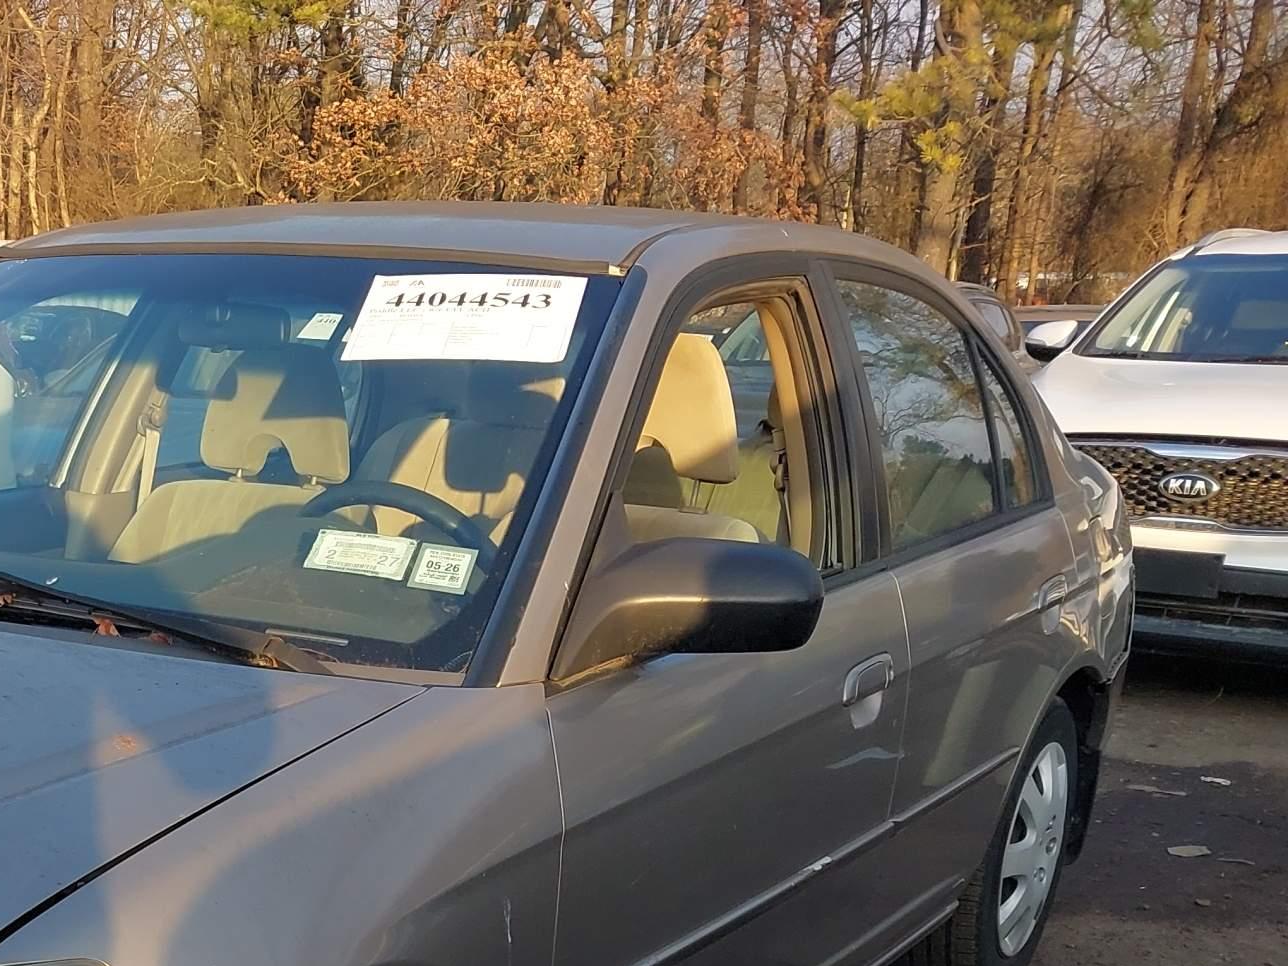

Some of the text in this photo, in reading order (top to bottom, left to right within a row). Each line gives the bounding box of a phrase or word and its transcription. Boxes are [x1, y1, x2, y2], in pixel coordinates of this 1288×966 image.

[385, 291, 552, 309] 44044543
[1168, 478, 1207, 496] KIA
[376, 555, 401, 568] 27
